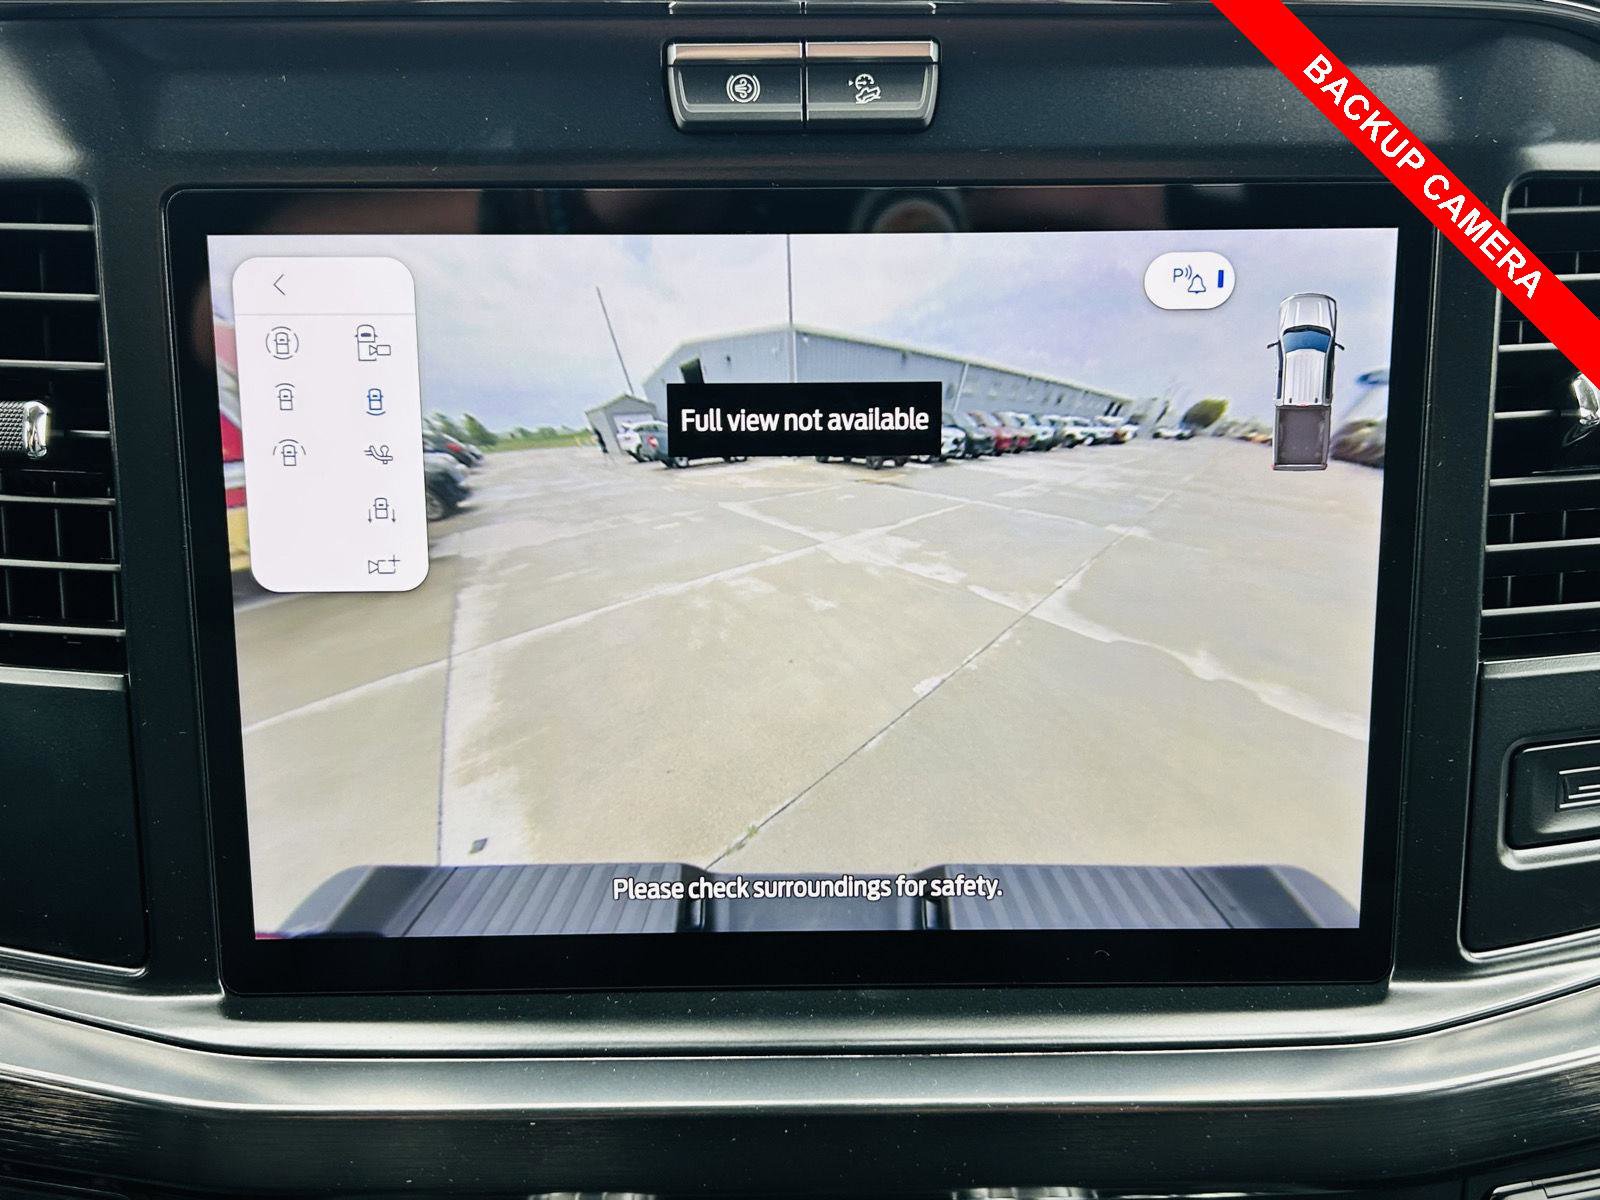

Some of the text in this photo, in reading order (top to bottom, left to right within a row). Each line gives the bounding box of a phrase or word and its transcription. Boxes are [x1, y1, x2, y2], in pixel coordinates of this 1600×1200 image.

[681, 407, 930, 432] Full view not available
[612, 874, 1003, 901] Please check surroundings for safety.
